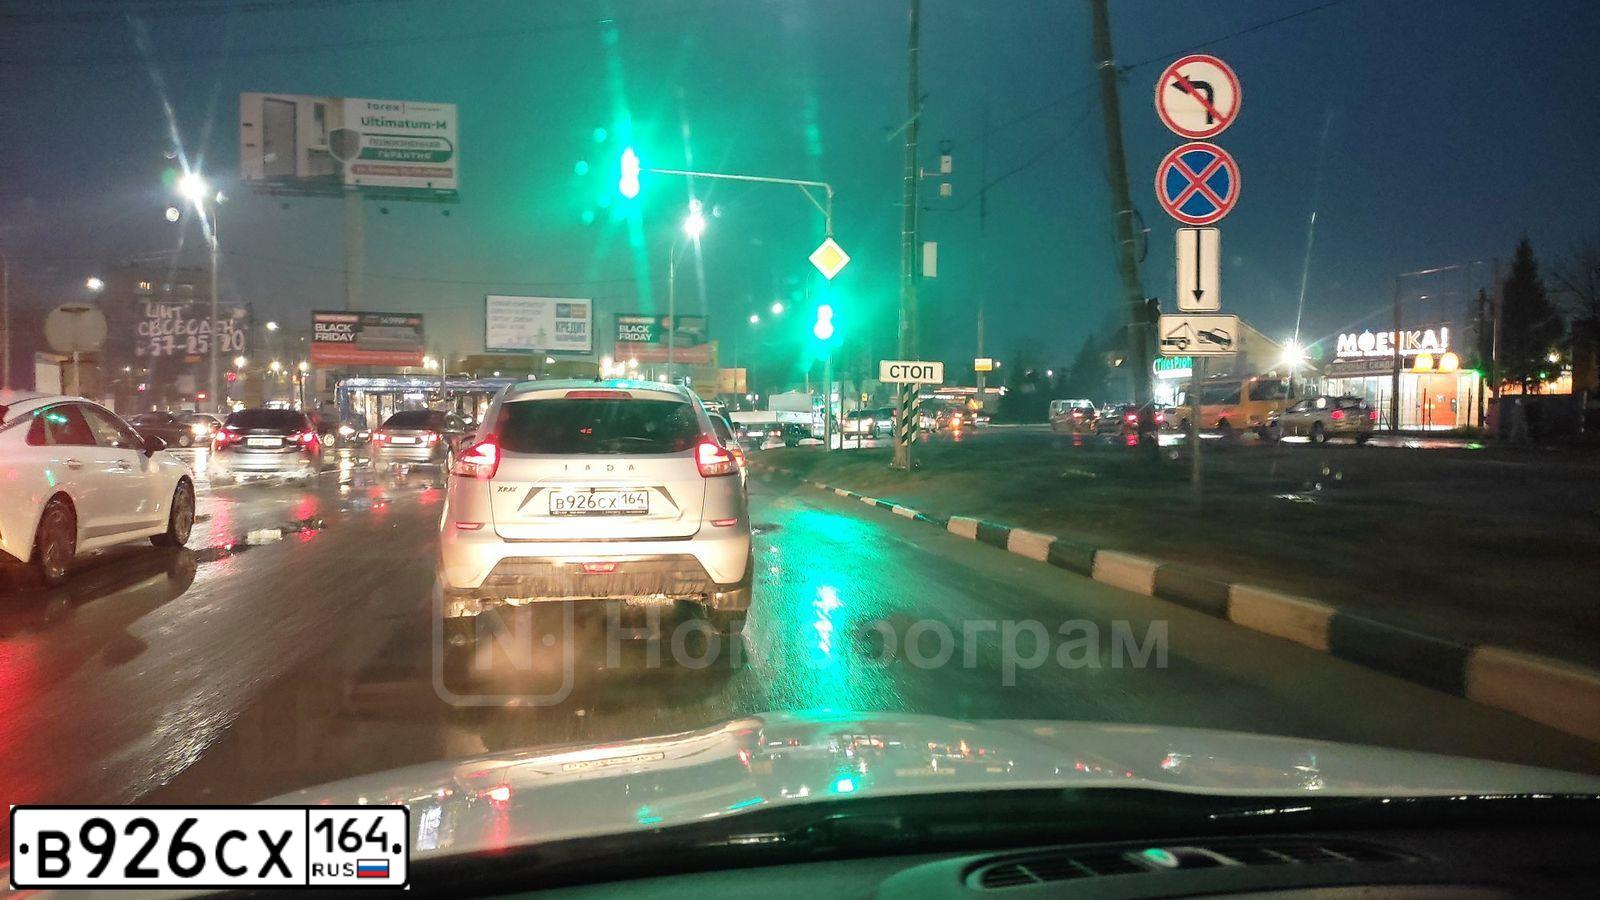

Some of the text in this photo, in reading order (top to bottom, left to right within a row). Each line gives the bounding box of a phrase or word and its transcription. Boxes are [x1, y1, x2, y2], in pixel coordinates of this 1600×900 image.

[361, 116, 447, 130] Ultimatum-M
[315, 323, 352, 333] BLACK
[619, 325, 650, 333] BLACK
[315, 332, 356, 342] FRIDAY
[619, 332, 653, 341] FRIDAY
[889, 365, 934, 379] СТОП
[621, 492, 645, 505] 164
